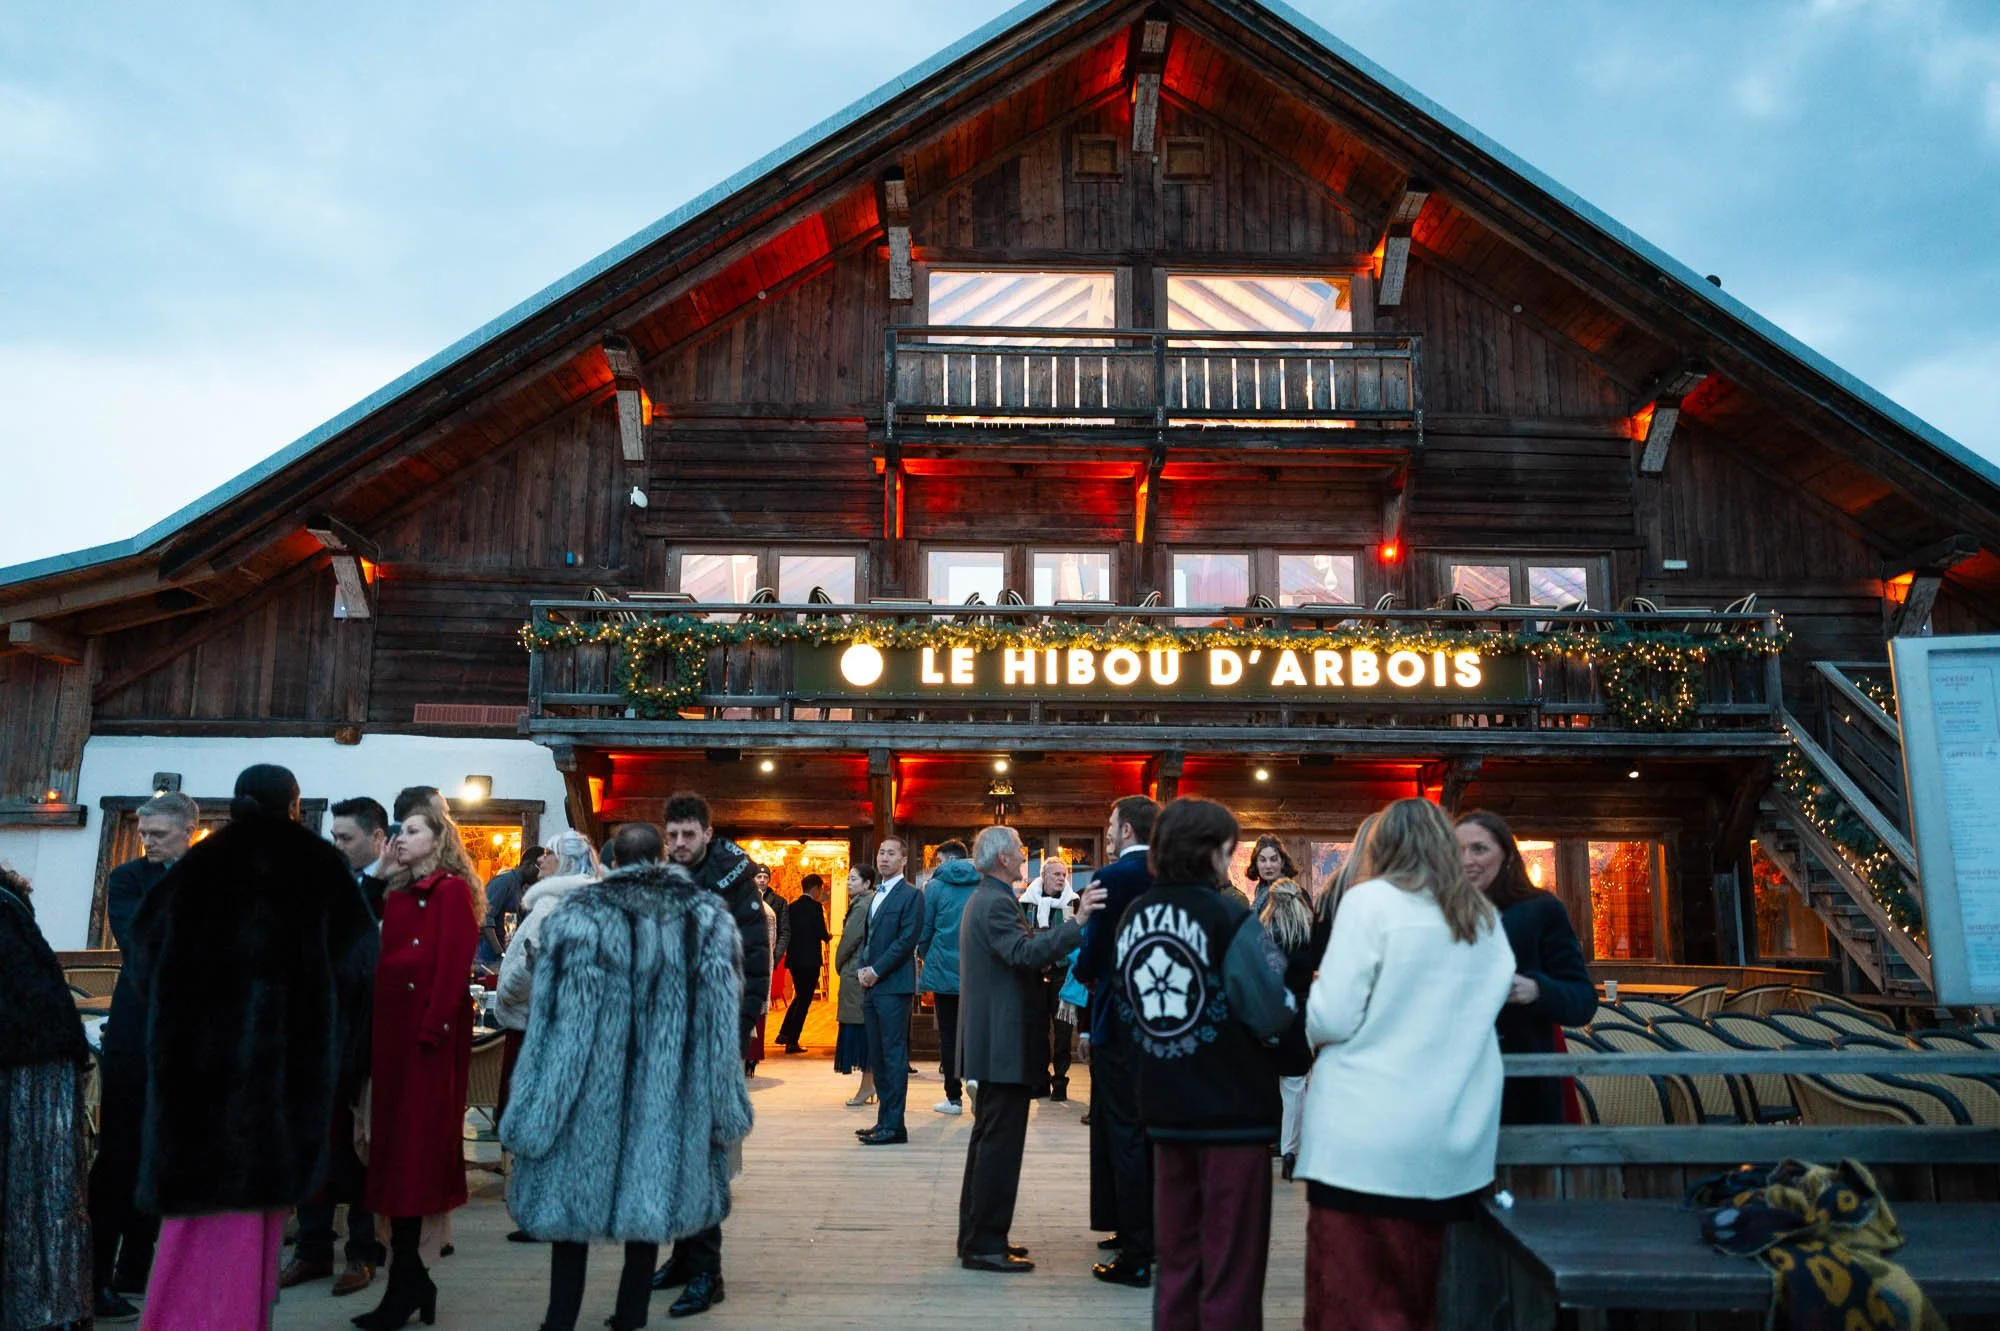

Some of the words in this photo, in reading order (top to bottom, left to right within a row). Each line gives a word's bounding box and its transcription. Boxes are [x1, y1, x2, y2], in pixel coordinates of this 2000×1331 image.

[921, 648, 974, 684] LE
[1004, 648, 1179, 686] HIBOU
[1210, 649, 1482, 687] D'ARBOIS
